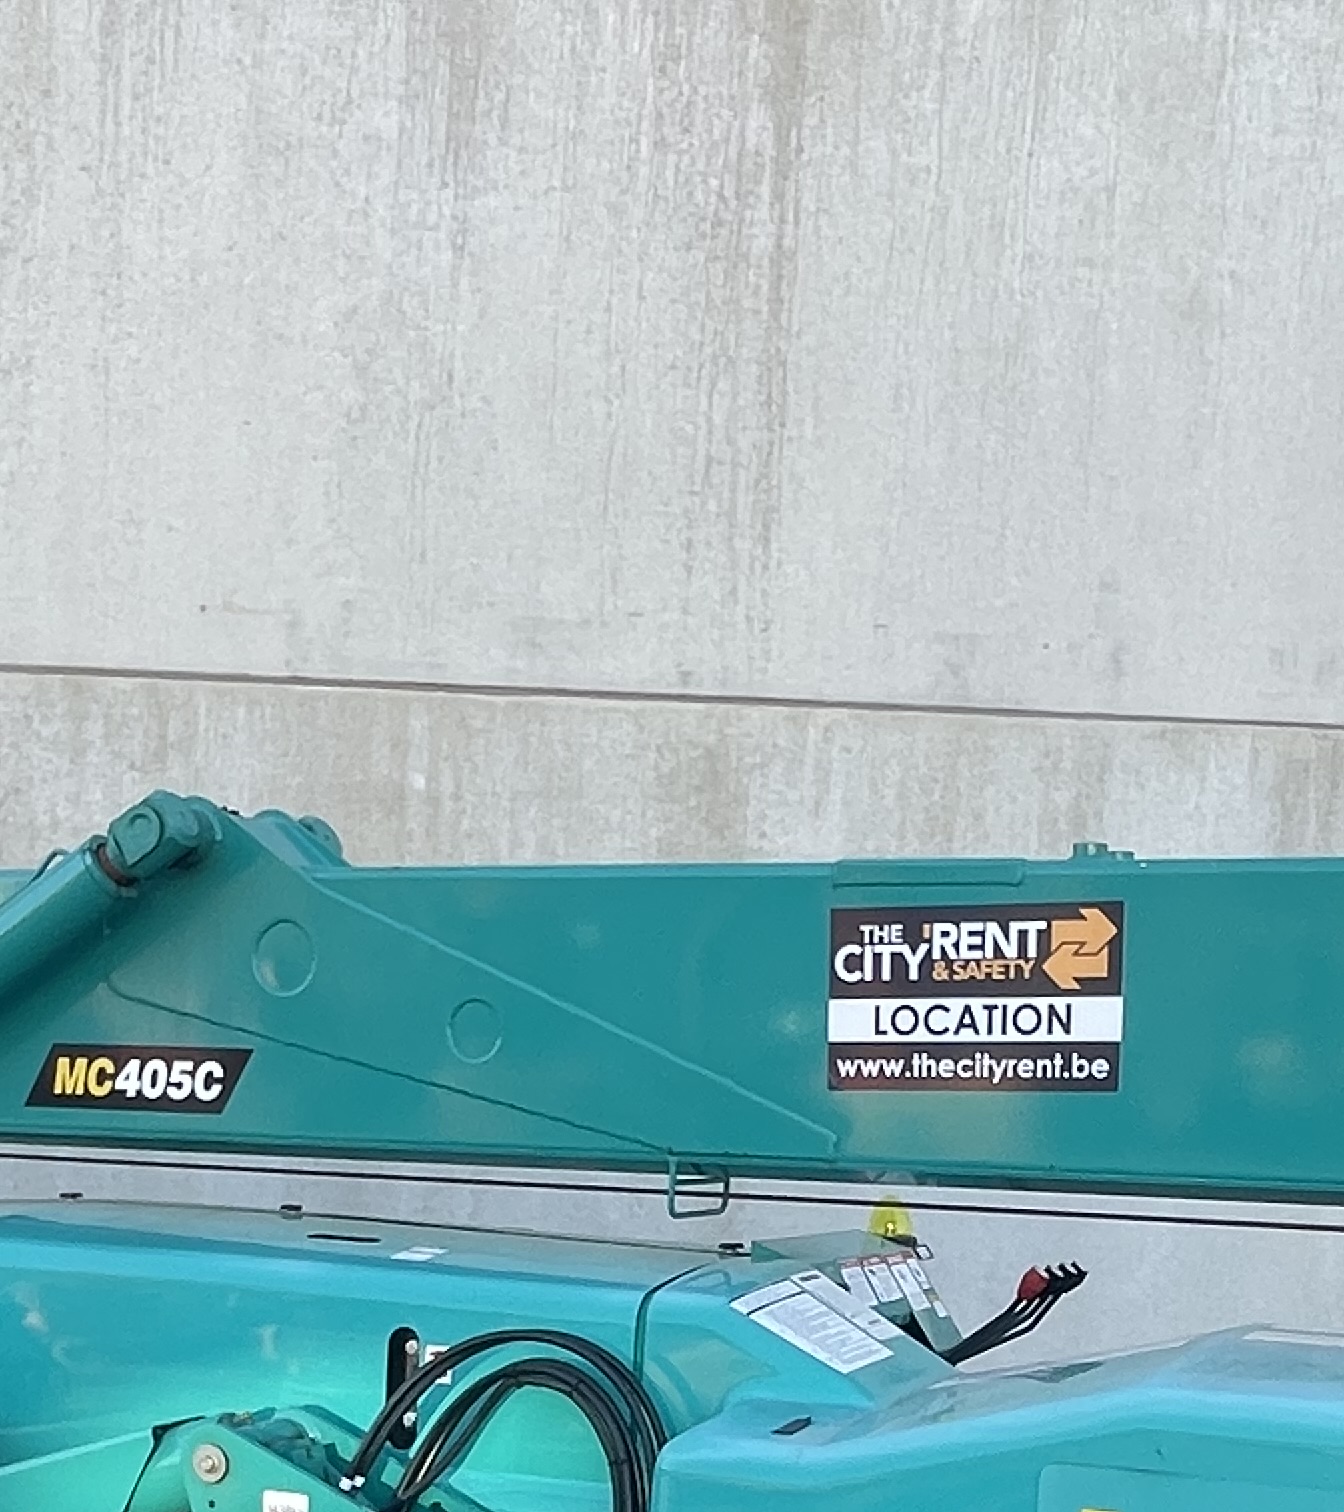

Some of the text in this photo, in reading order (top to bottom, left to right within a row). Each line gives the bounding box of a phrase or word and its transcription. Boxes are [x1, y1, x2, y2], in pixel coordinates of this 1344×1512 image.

[859, 923, 904, 944] THE
[931, 958, 1036, 982] & SAFETY
[873, 1003, 1072, 1036] LOCATION
[53, 1056, 225, 1102] MC405C
[836, 1051, 1111, 1085] www.thecityrent.be
